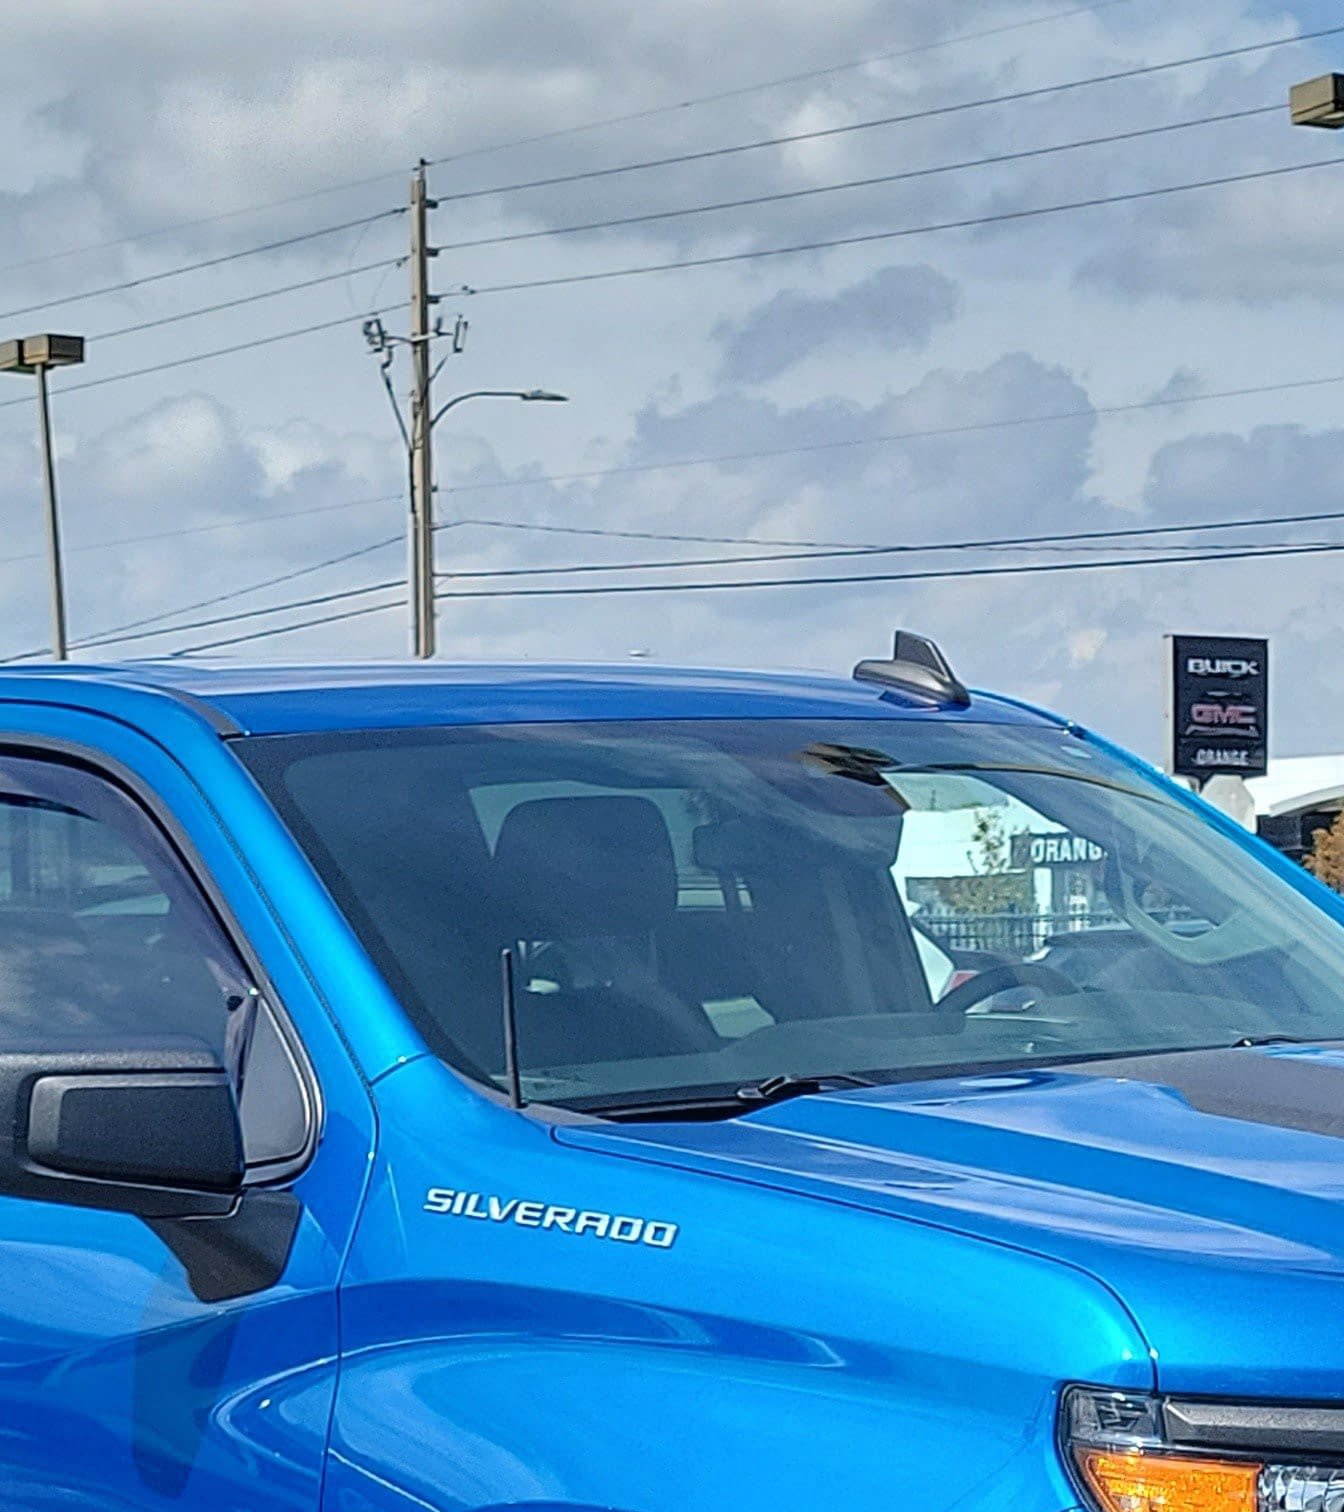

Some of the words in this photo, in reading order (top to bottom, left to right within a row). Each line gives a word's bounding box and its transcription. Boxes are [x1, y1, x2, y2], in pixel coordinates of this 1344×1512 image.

[1187, 658, 1260, 677] BUICK
[1191, 703, 1257, 724] GMC
[423, 1187, 678, 1248] SILVERADO
